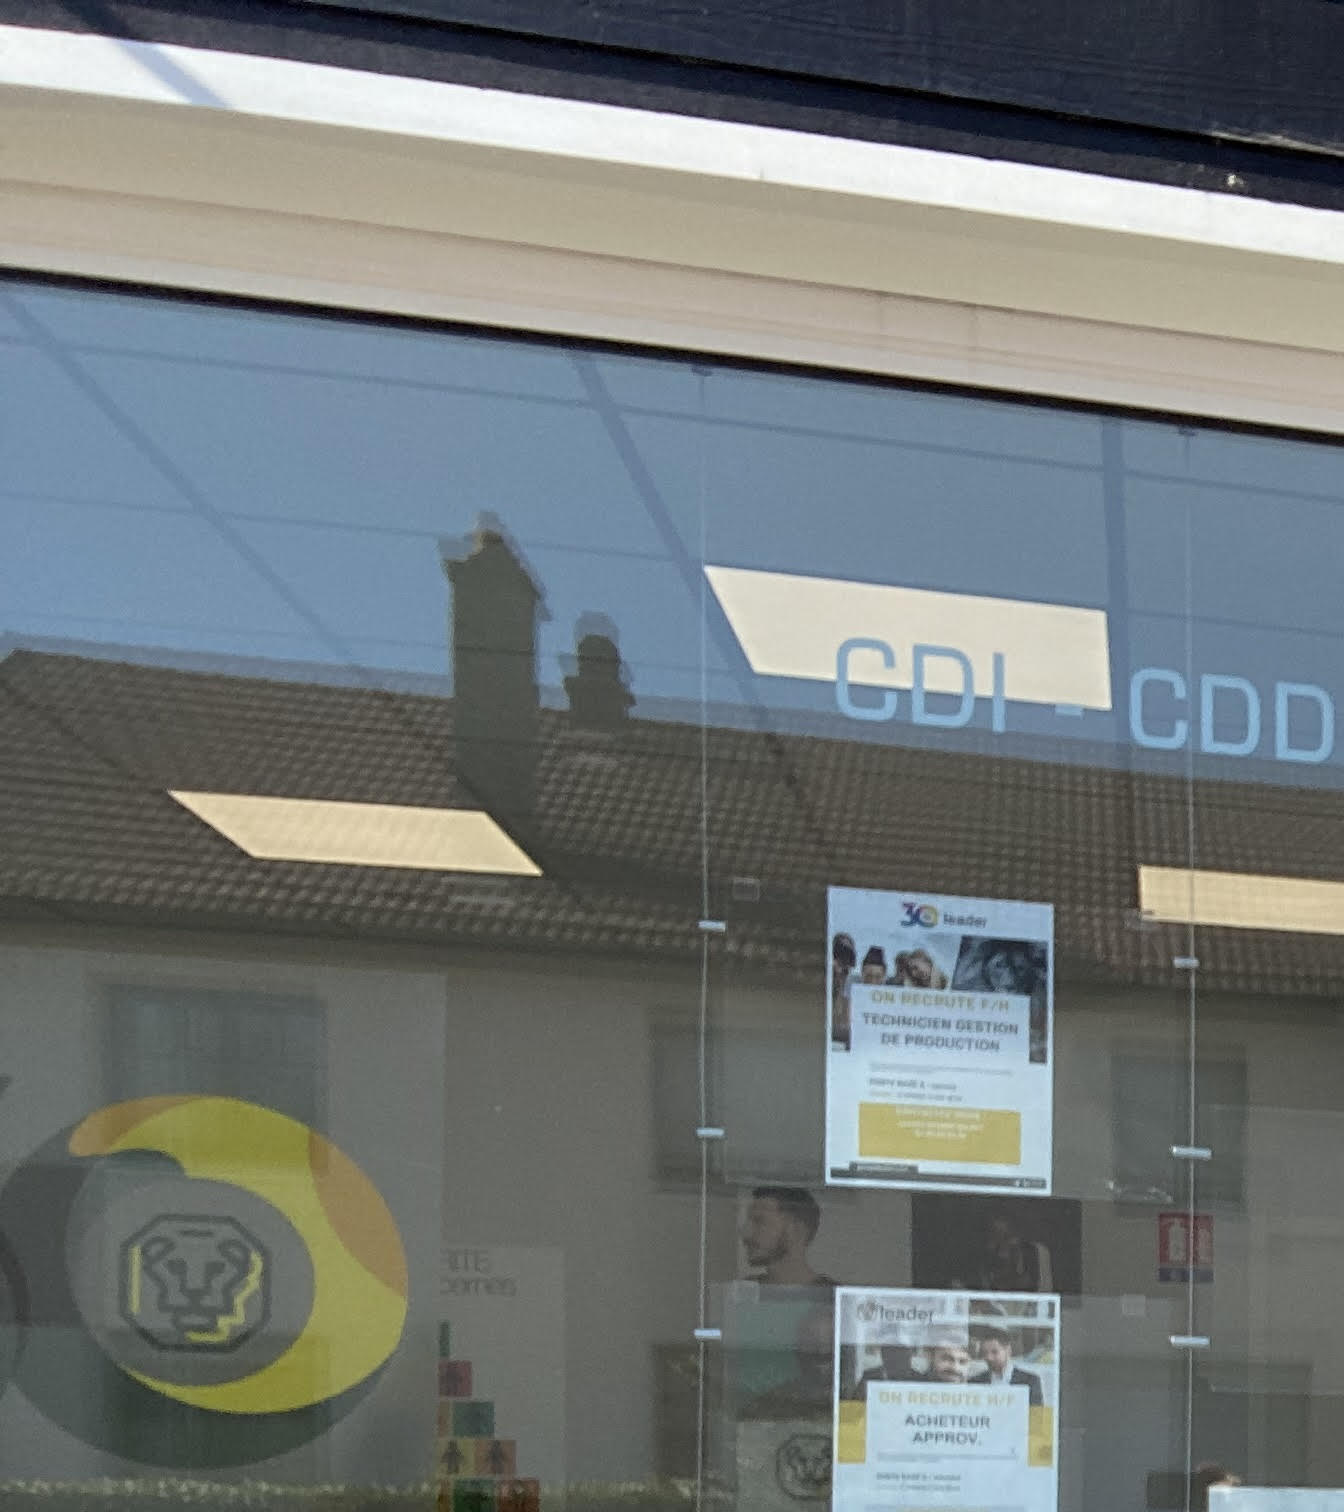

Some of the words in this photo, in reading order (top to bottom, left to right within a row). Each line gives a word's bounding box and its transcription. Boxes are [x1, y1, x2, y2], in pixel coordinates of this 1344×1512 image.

[835, 637, 1004, 733] CDI
[1129, 667, 1336, 763] CDD
[863, 1012, 951, 1030] TECHNICIEN
[955, 1019, 1019, 1035] GESTION
[880, 1032, 900, 1046] DE
[904, 1033, 1001, 1052] PRODUCTION
[880, 1303, 935, 1322] leader
[904, 1413, 991, 1429] ACHETEUR
[912, 1431, 983, 1446] APPROV.
